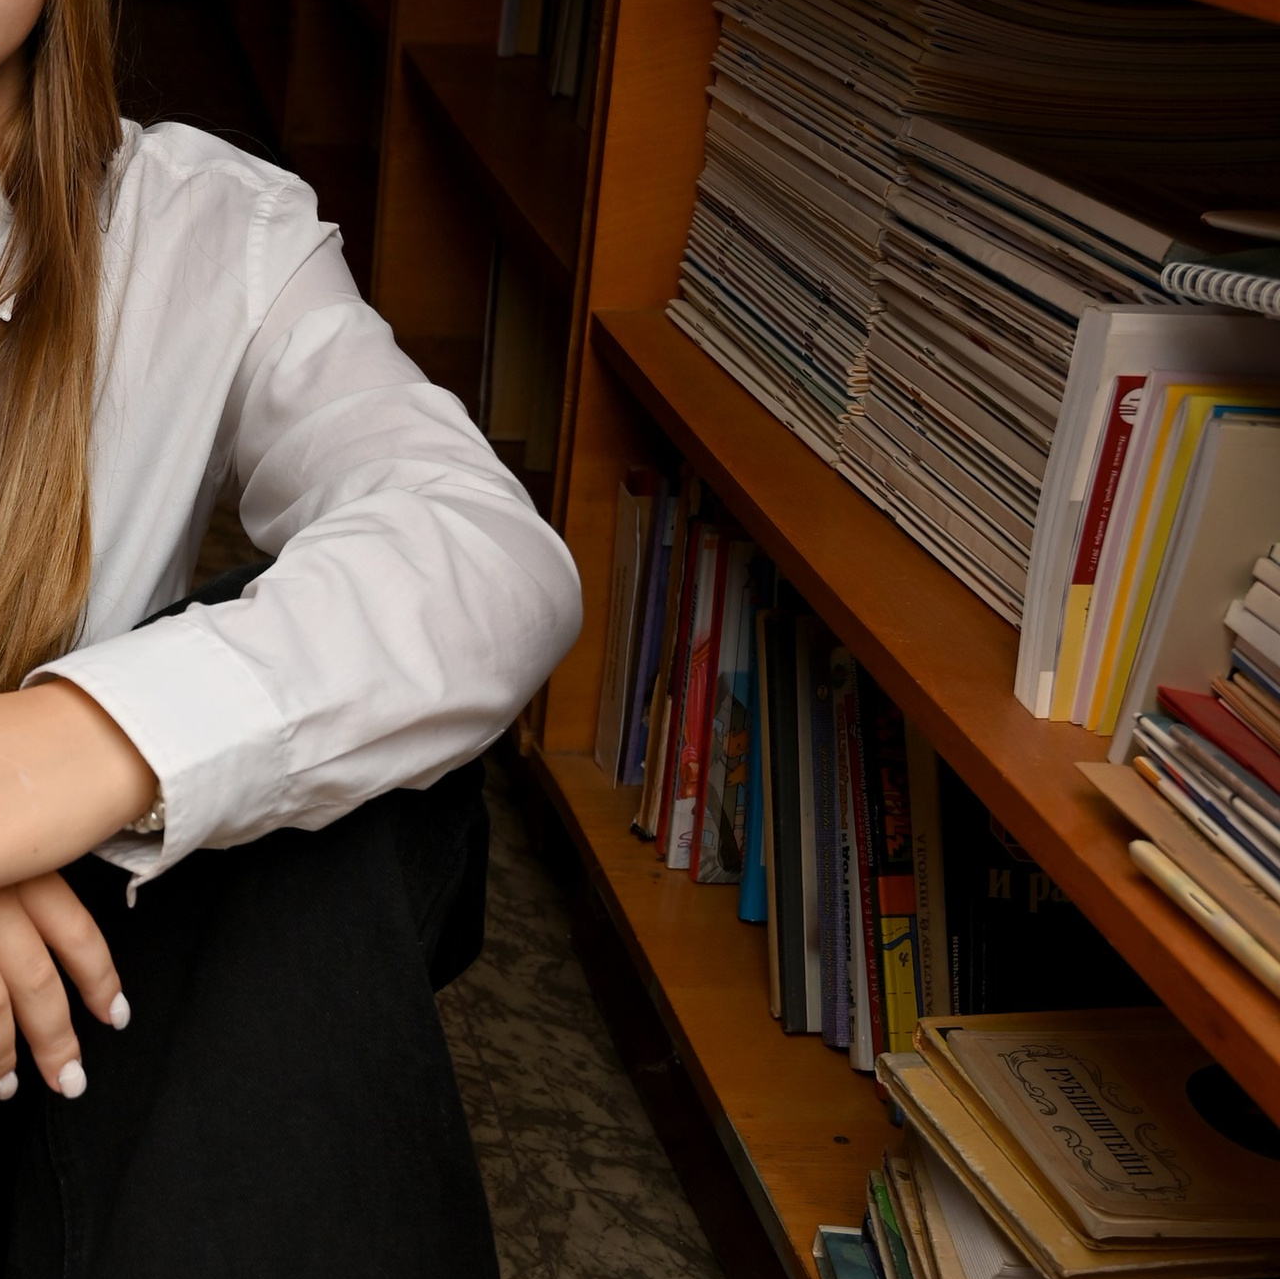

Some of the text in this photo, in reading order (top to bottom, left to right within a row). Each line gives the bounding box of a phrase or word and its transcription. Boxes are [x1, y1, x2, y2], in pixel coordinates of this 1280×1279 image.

[836, 701, 849, 830] РОЖДЕСТВО
[841, 843, 849, 885] ГОД
[916, 831, 928, 909] ШКОЛА
[987, 868, 1012, 900] и
[1045, 1068, 1154, 1176] РУБИНШТЕЙН
